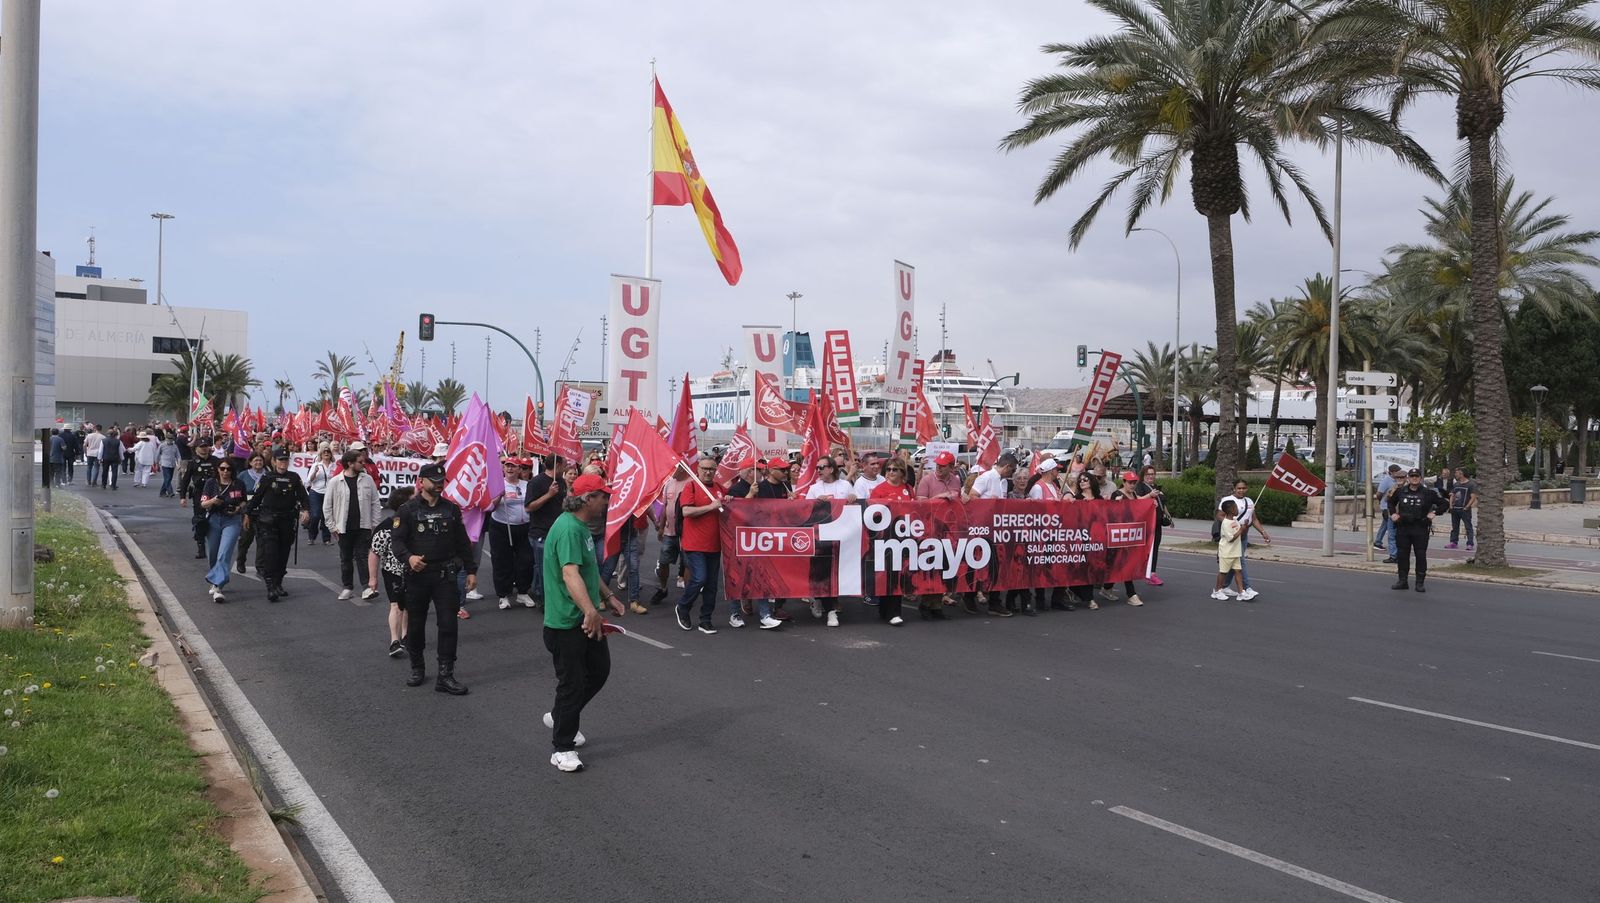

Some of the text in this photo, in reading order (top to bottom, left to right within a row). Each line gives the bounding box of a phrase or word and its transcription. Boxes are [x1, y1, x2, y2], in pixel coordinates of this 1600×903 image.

[896, 270, 912, 380] UGT
[621, 284, 650, 402] UGT
[830, 334, 854, 410] CCOO
[1080, 356, 1118, 430] CCOO
[1271, 464, 1318, 496] CCOO
[894, 514, 925, 538] de
[968, 526, 990, 536] 2026
[993, 513, 1063, 528] DERECHOS,
[740, 531, 787, 552] UGT
[993, 528, 1092, 543] NO TRINCHERAS.
[1111, 527, 1143, 543] CCOO
[874, 537, 992, 580] mayo
[1027, 543, 1104, 554] SALARIOS, VIVIENDA
[1027, 555, 1087, 565] Y DEMOCRACIA
